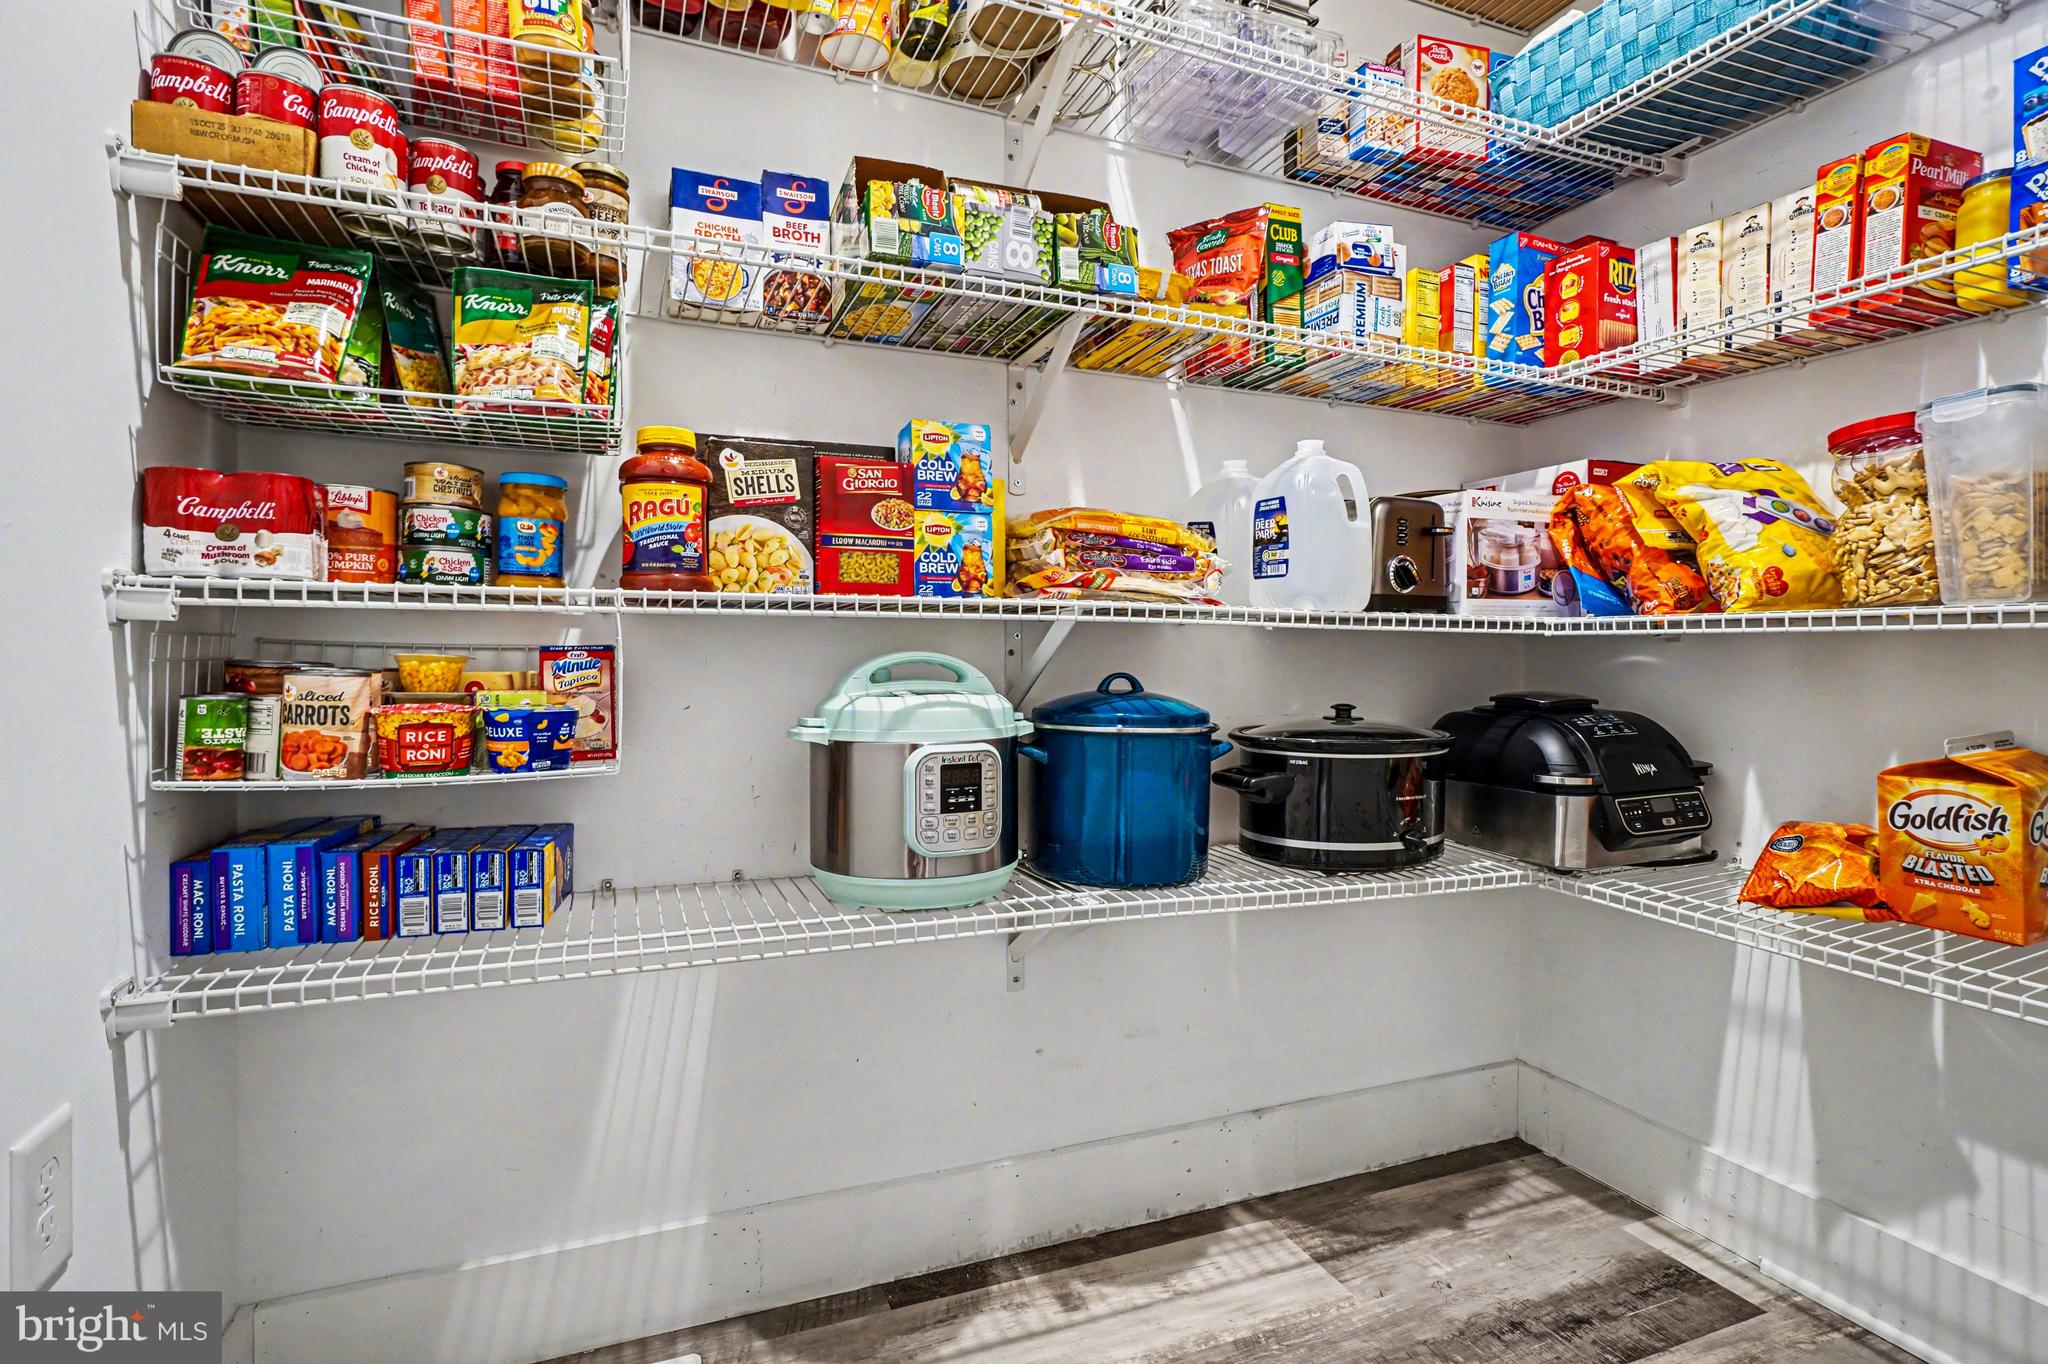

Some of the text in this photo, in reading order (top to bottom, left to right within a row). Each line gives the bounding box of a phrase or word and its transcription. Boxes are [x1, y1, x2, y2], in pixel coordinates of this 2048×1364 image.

[151, 67, 232, 105] Campbell's
[323, 99, 399, 137] Campbell's
[343, 152, 381, 168] Cream of
[409, 151, 474, 179] Campbell's
[345, 162, 379, 176] Chicken
[1911, 157, 1944, 180] Pearl
[700, 187, 736, 200] SWANSON
[778, 189, 814, 201] SWANSON
[697, 220, 739, 234] CHICKEN
[785, 220, 808, 231] BEEF
[1270, 223, 1298, 242] CLUB
[772, 226, 821, 244] BROTH
[933, 237, 942, 257] CANS
[943, 241, 959, 257] 8
[1006, 240, 1034, 269] 8
[987, 241, 1000, 270] CANS
[212, 254, 289, 280] Knorr
[1209, 253, 1243, 275] TOAST
[1117, 271, 1132, 286] 8
[1608, 258, 1637, 288] RITZ
[306, 278, 355, 295] MARINARA
[463, 293, 529, 316] Knorr
[1355, 282, 1367, 338] REMIUM
[925, 434, 949, 442] LIPTON
[740, 468, 786, 476] MEDIUM
[918, 459, 955, 471] COLD
[856, 468, 882, 479] SAN
[917, 471, 958, 482] BREW
[733, 473, 796, 496] SHELLS
[842, 477, 898, 490] GIORGIO
[330, 489, 364, 504] Libby's
[916, 491, 932, 499] 22
[177, 495, 277, 523] Campbell's
[415, 514, 448, 523] Chicken
[1255, 518, 1276, 531] DEER
[163, 529, 172, 538] 4
[926, 525, 951, 534] LIPTON
[1255, 529, 1278, 540] PARK
[639, 533, 680, 547] TRADITIONAL
[648, 540, 669, 550] SAUCE
[200, 551, 250, 560] Mushroom
[345, 552, 376, 562] PURE
[439, 557, 471, 567] Chicken
[920, 552, 957, 563] COLD
[447, 564, 463, 572] Sea
[919, 563, 958, 574] BREW
[919, 584, 934, 593] 22
[552, 659, 602, 676] Minute
[558, 673, 598, 689] Tapioca
[297, 691, 346, 702] sliced
[282, 704, 350, 726] CARROTS
[405, 730, 447, 743] RICE
[406, 748, 446, 761] RONI
[941, 753, 981, 764] Instant Pot
[1889, 800, 2008, 834] Goldfish
[1926, 851, 1965, 864] FLAVOR
[1902, 854, 1994, 886] BLASTED
[1914, 878, 1981, 895] XTRA CHEDDAR
[232, 863, 246, 939] PASTA RONI
[282, 859, 295, 932] PASTA RONI
[326, 866, 337, 926] MAC RONI
[368, 864, 379, 928] RICE RONI
[193, 879, 204, 942] MAC RONI
